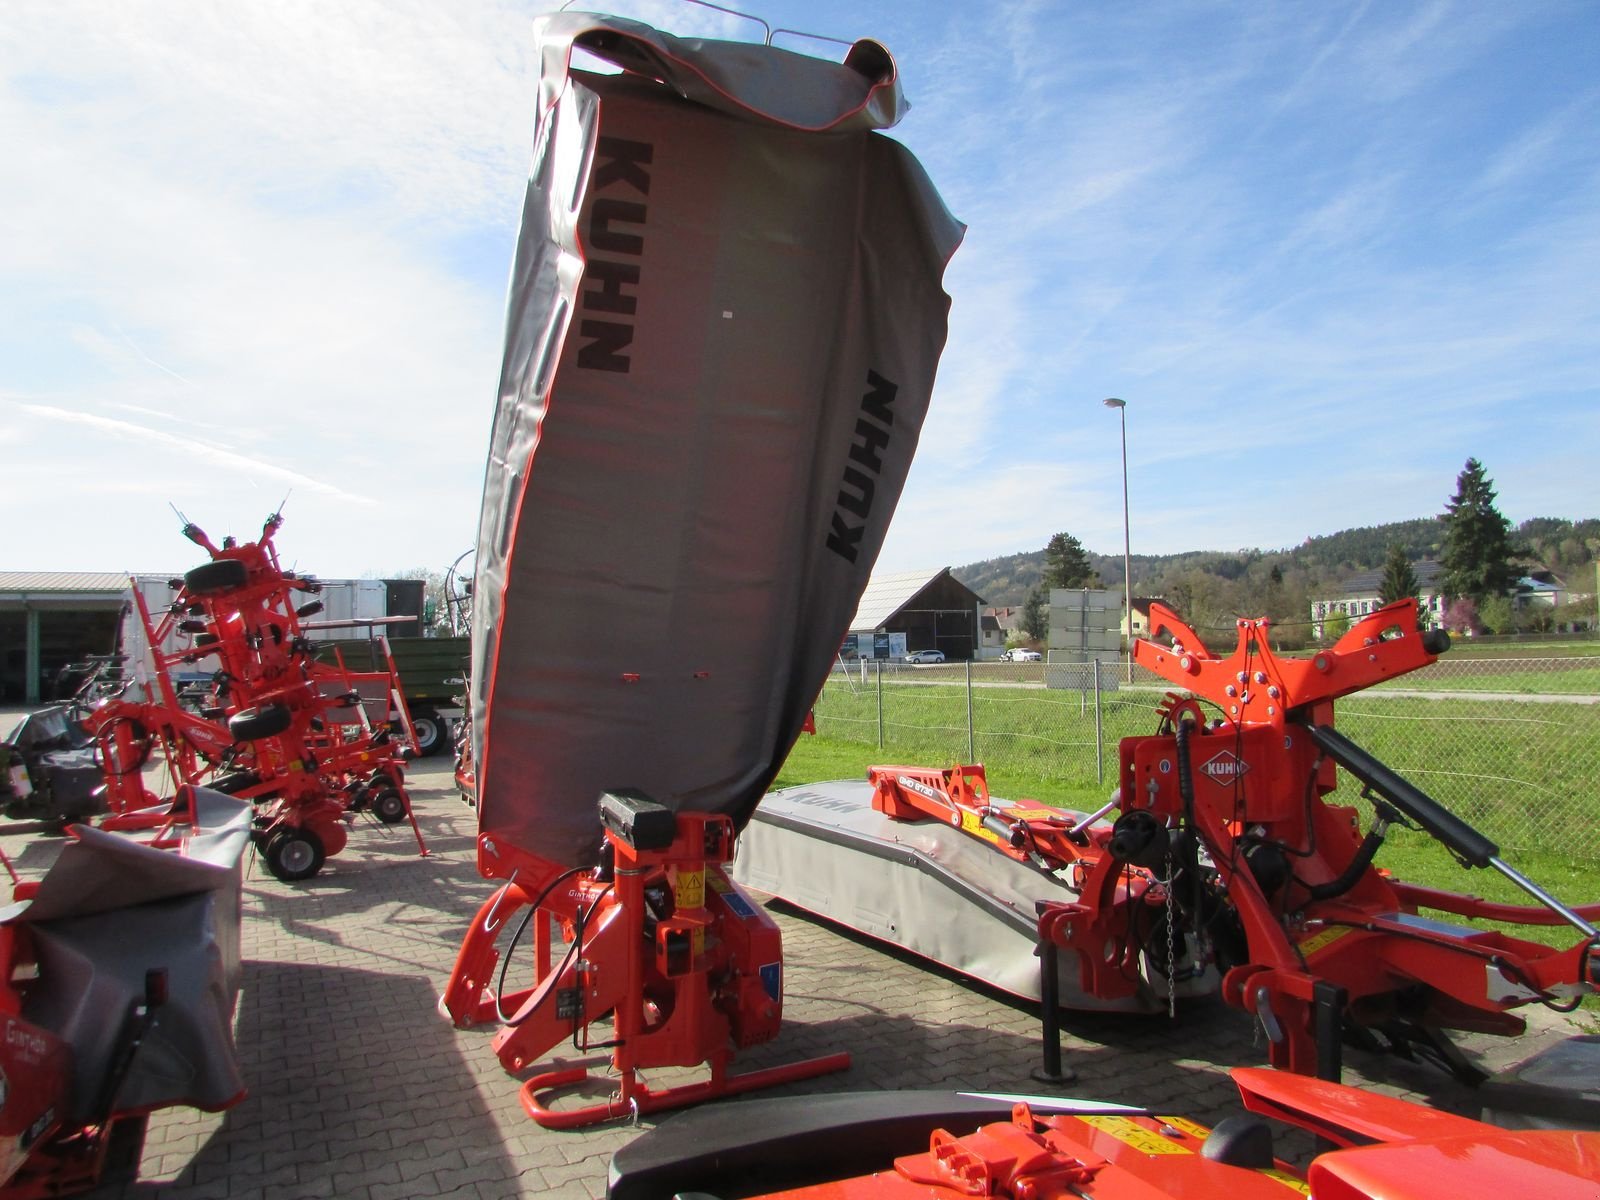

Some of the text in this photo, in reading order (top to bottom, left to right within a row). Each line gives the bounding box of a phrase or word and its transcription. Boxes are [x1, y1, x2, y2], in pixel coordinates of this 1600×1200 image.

[577, 136, 654, 373] KUHN
[826, 368, 899, 564] KUHN
[785, 792, 863, 813] KUHN
[899, 776, 914, 788] GMD
